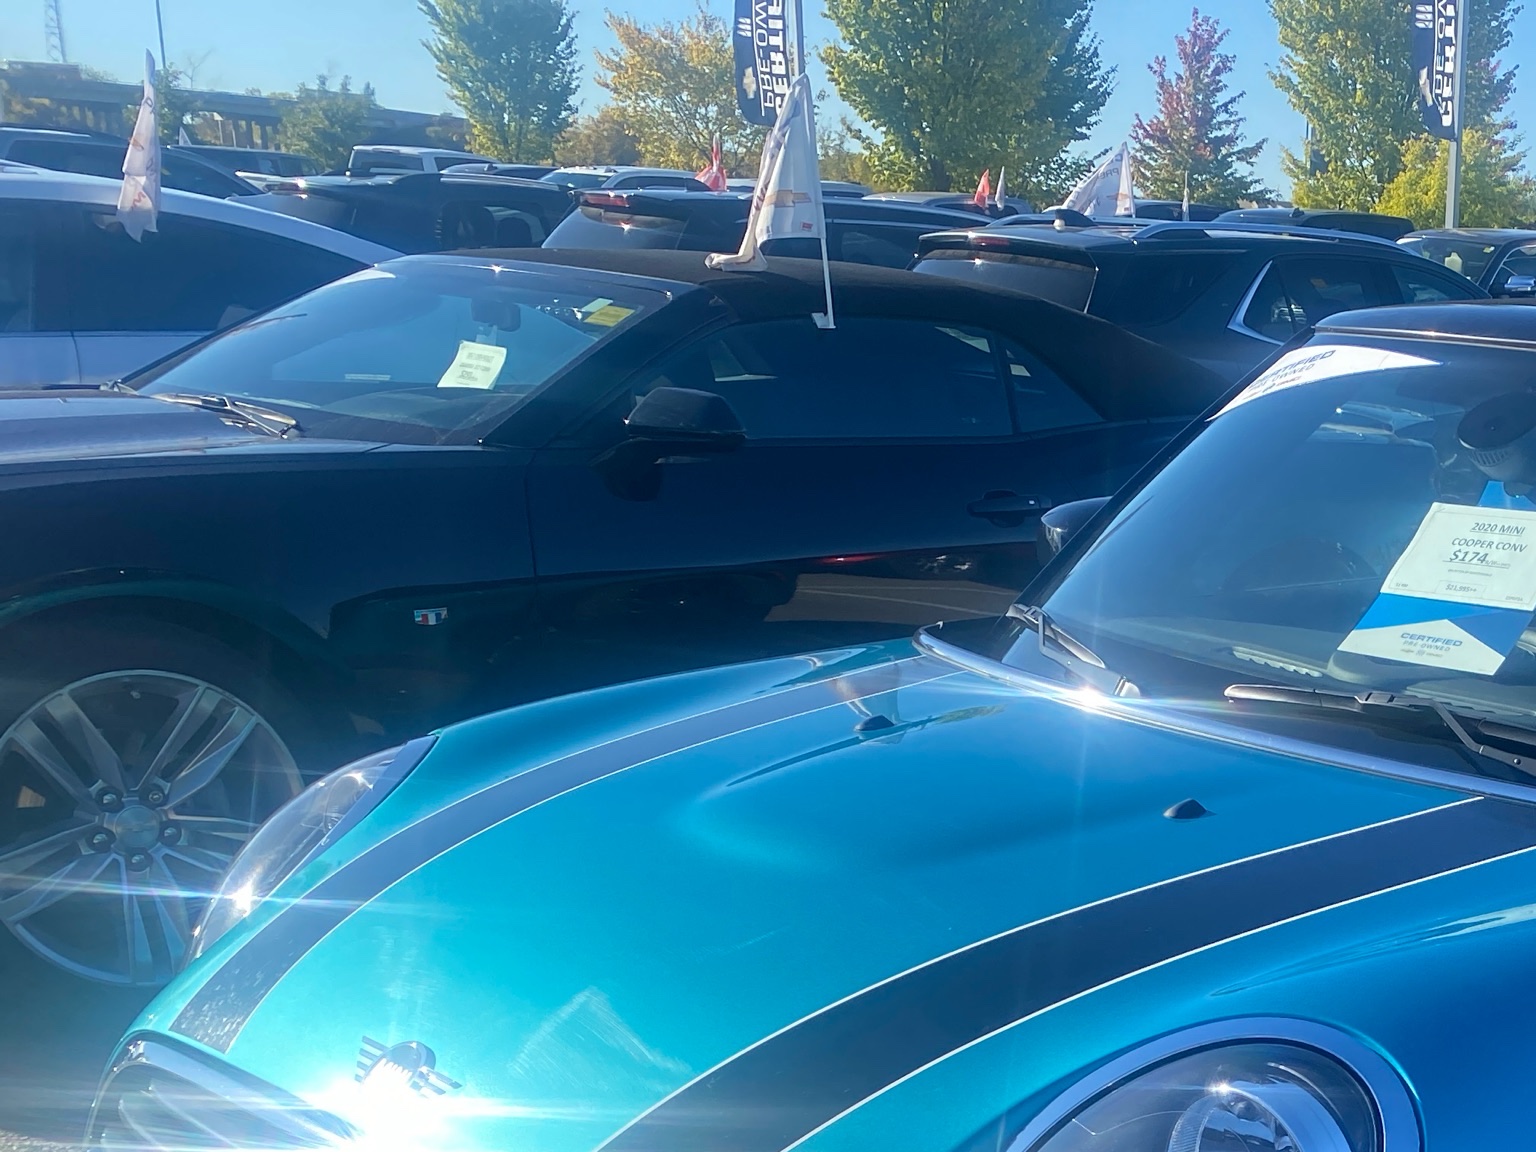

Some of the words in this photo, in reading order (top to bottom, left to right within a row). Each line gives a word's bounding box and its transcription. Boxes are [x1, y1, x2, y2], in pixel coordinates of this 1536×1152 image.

[1472, 522, 1497, 533] 2020
[1498, 524, 1526, 535] MINI
[1451, 537, 1495, 549] COOPER
[1495, 541, 1528, 553] CONV
[1449, 548, 1489, 565] $174
[1400, 632, 1463, 647] CERTIFIED
